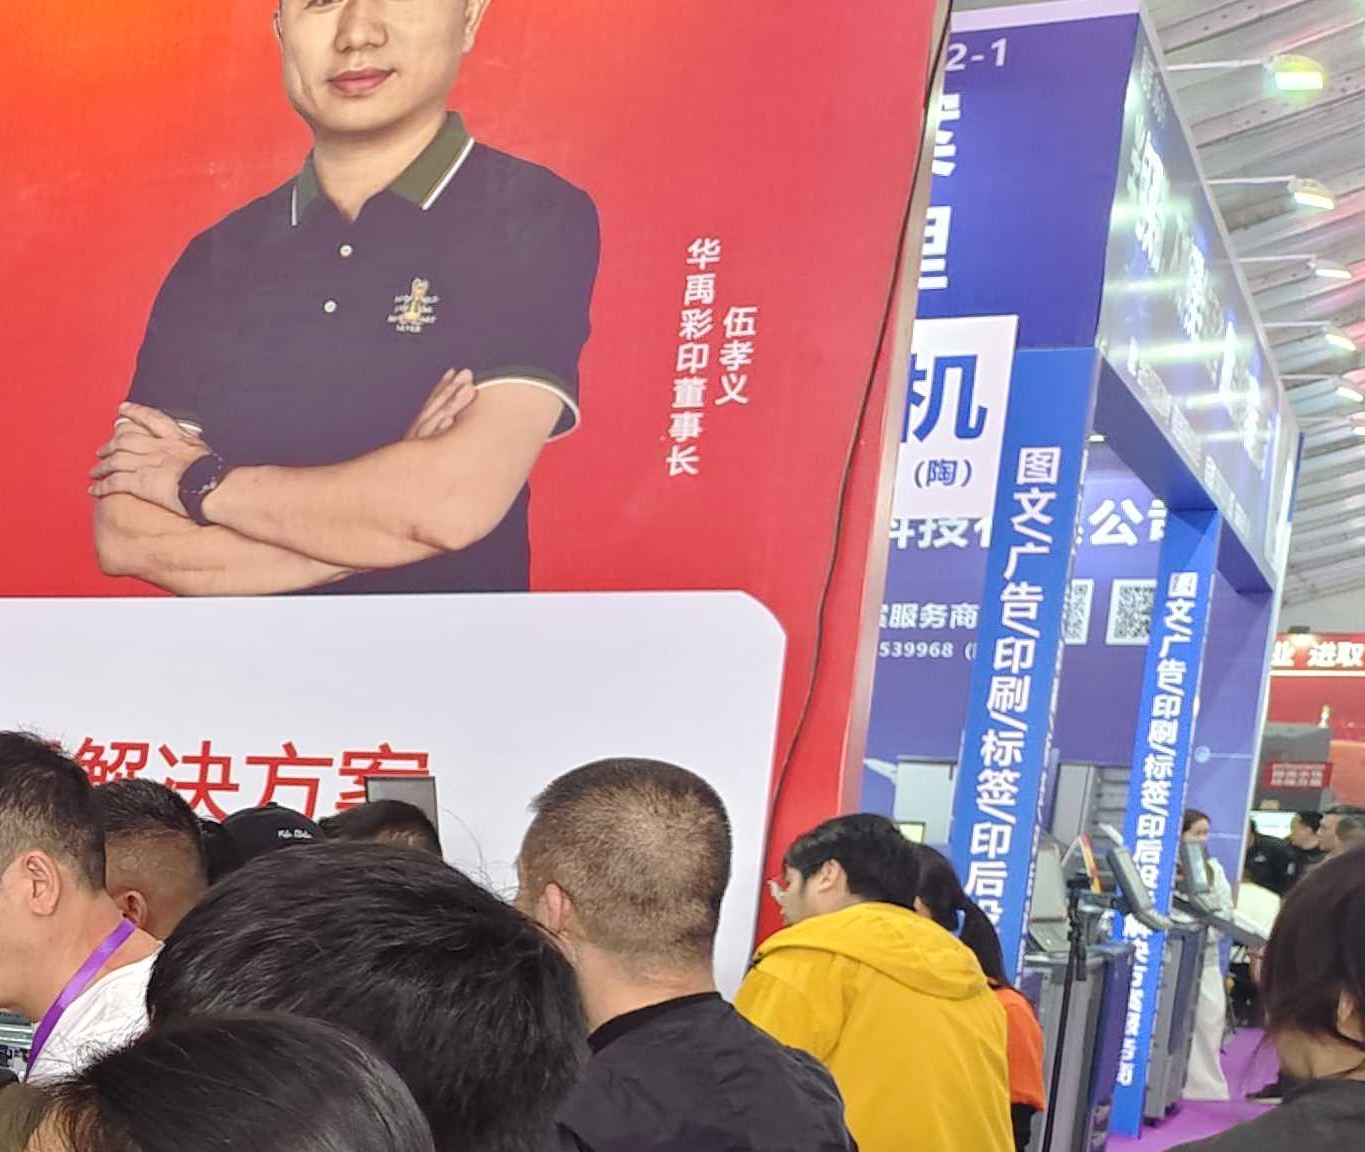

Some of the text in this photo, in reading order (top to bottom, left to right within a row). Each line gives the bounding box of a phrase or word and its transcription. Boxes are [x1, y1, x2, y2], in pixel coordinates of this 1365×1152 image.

[666, 238, 722, 477] 华禹彩印董事长
[714, 306, 758, 406] 伍孝义
